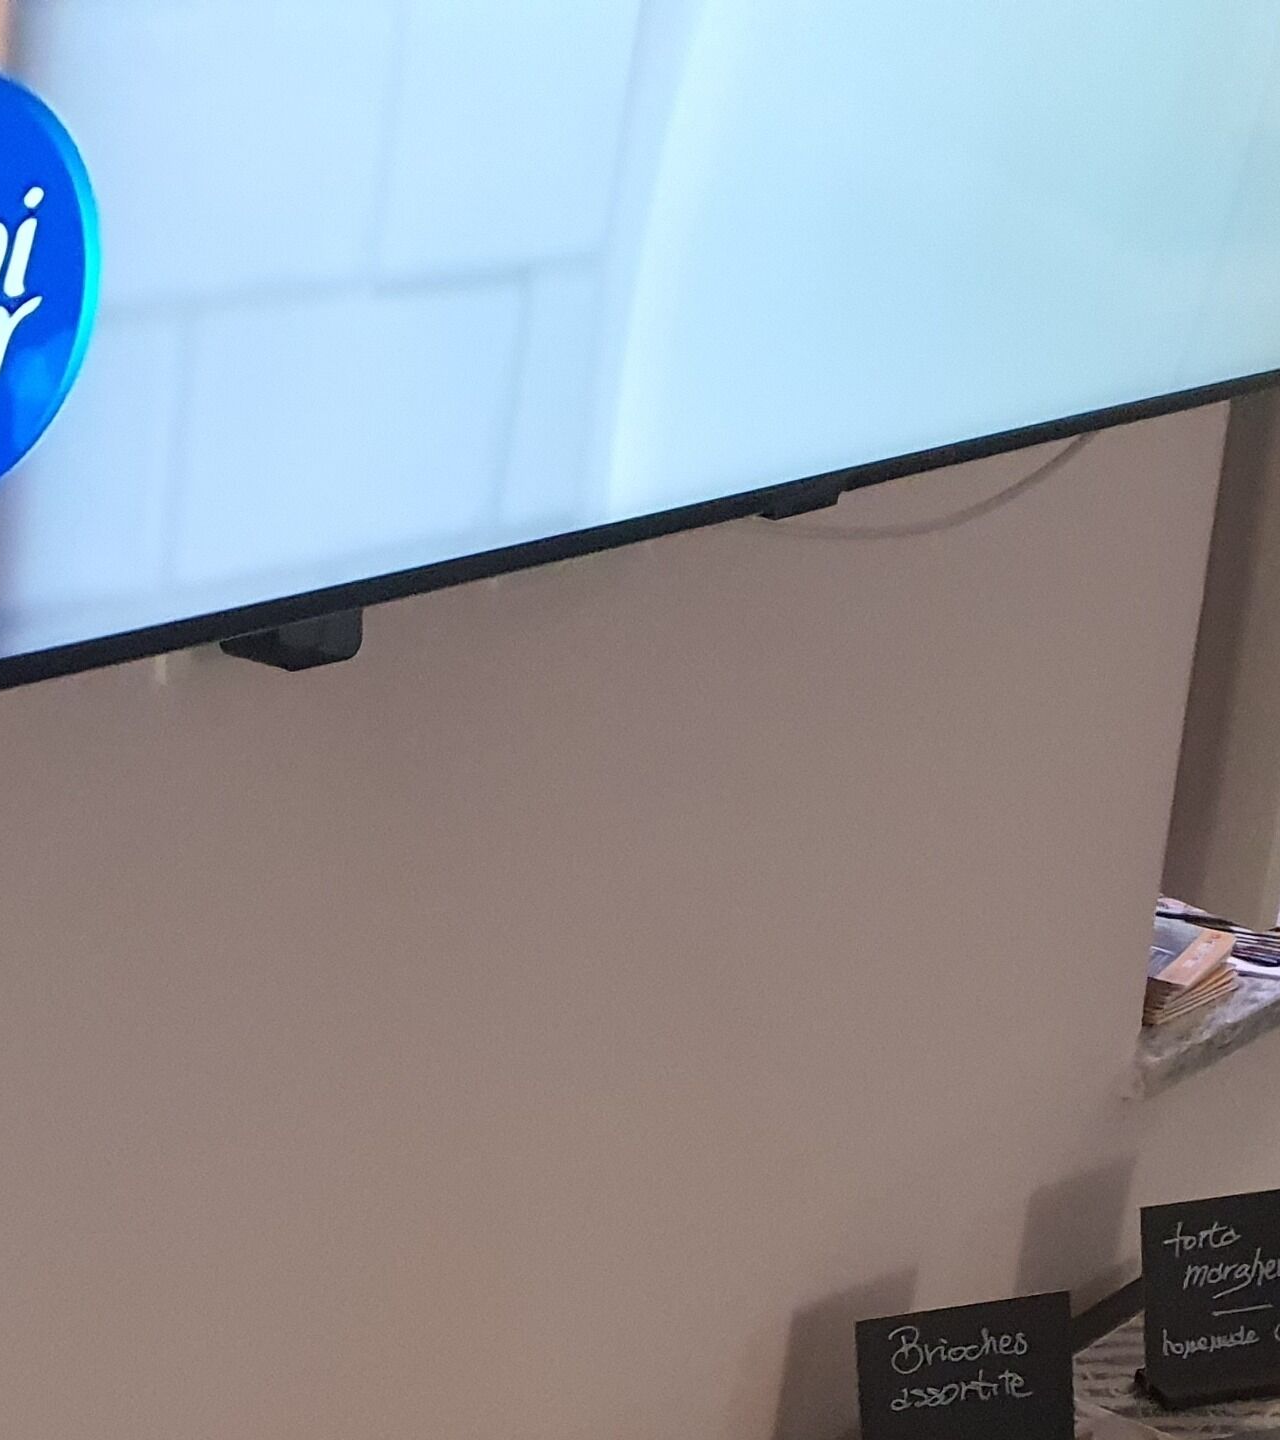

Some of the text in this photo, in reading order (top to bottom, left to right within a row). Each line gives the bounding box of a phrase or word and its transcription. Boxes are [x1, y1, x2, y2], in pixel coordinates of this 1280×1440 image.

[1163, 1221, 1242, 1258] torta
[888, 1325, 1028, 1375] Brioches
[890, 1369, 1034, 1412] assortite
